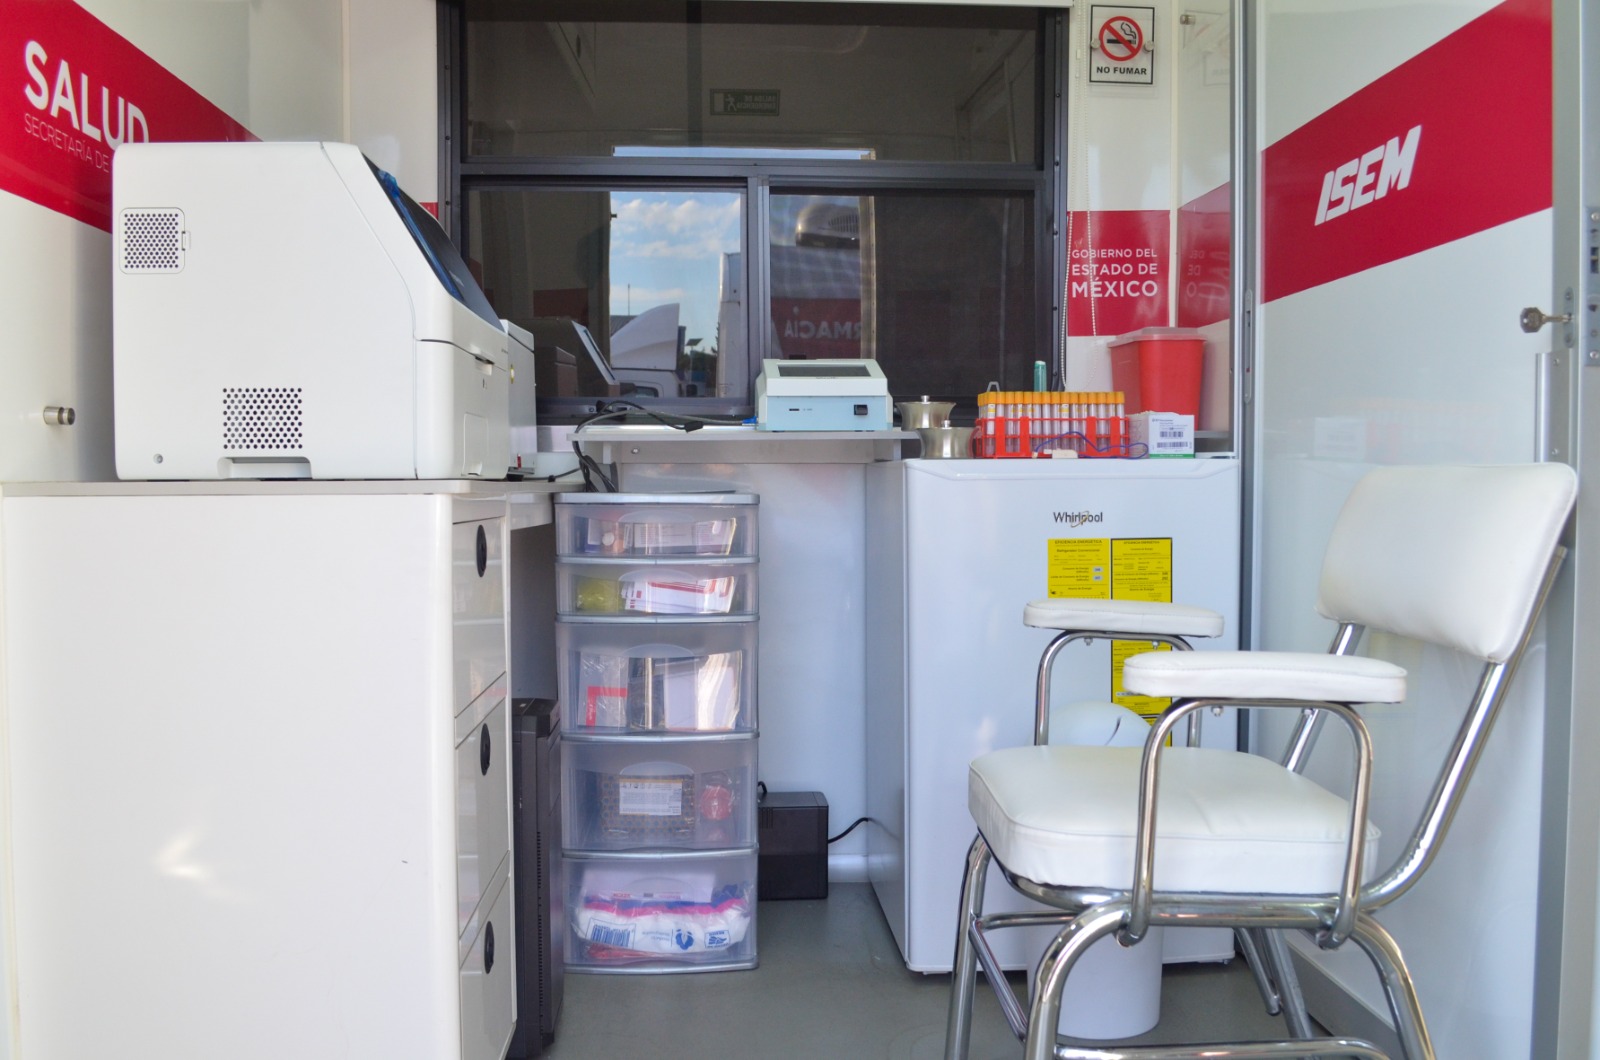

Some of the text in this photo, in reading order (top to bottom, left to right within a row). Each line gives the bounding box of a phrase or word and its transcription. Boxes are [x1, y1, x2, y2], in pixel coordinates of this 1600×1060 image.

[1096, 66, 1147, 75] NO FUMAR
[24, 40, 149, 151] SALUD
[24, 113, 110, 173] SECRETARÍA DE
[1314, 124, 1422, 226] ISEM
[1072, 249, 1157, 259] GOBIERNO DEL
[1072, 263, 1158, 276] ESTADO DE
[1072, 276, 1158, 298] MÉXICO
[1053, 511, 1103, 526] Whirlpool
